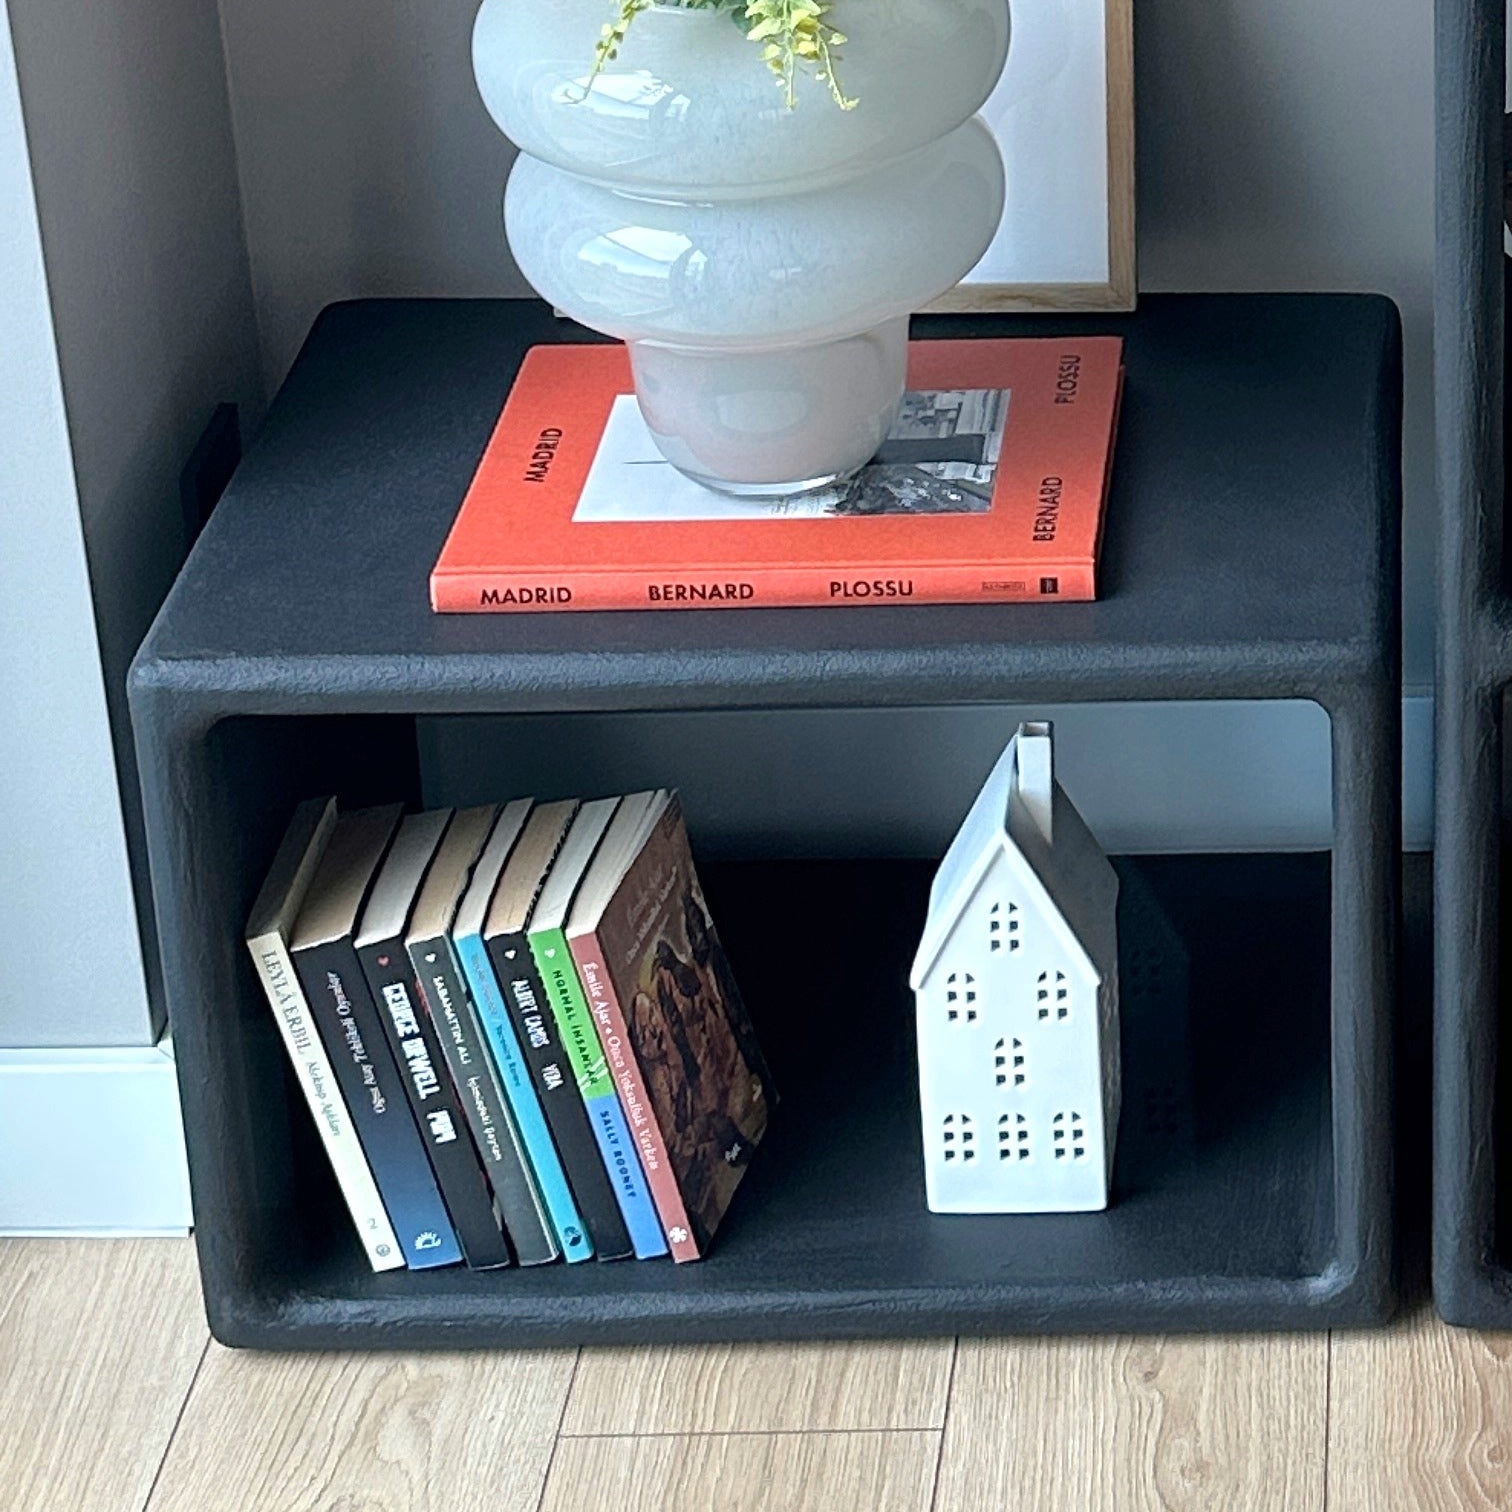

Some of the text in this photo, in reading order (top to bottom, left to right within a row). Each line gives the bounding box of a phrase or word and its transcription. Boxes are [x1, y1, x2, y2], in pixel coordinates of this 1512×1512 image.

[1054, 354, 1081, 405] PLOSSU
[523, 428, 563, 483] MADRID
[1032, 476, 1063, 542] BERNARD
[480, 580, 913, 606] MADRID BERNARD PLOSSU
[510, 978, 539, 1014] ALBERT
[552, 969, 574, 1021] NORMAL
[595, 1000, 612, 1032] Ajar
[401, 1036, 441, 1101] ORWELL
[600, 1110, 637, 1199] SALLY ROONEY
